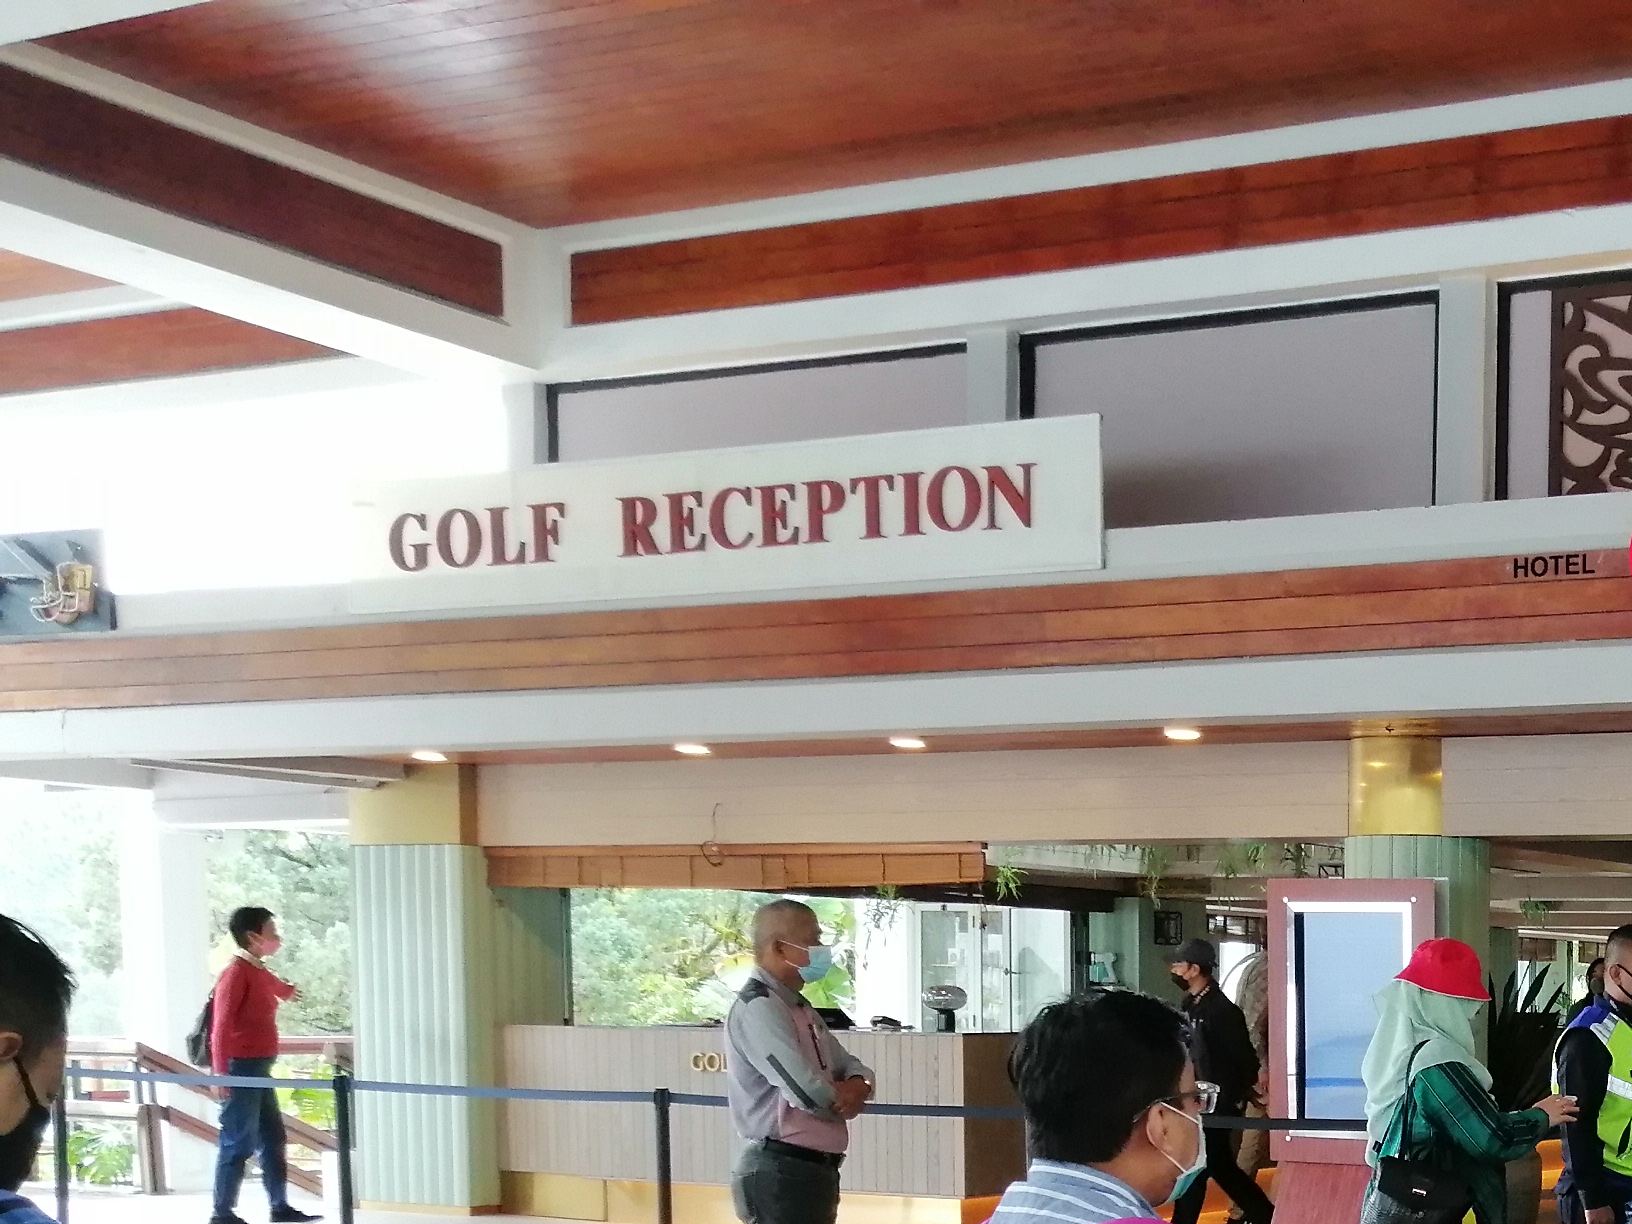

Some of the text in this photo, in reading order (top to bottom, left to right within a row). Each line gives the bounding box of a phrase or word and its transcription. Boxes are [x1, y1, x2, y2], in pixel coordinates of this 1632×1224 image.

[388, 462, 1038, 572] GOLF RECEPTION
[1513, 553, 1596, 578] HOTEL
[691, 1052, 728, 1073] GOL
